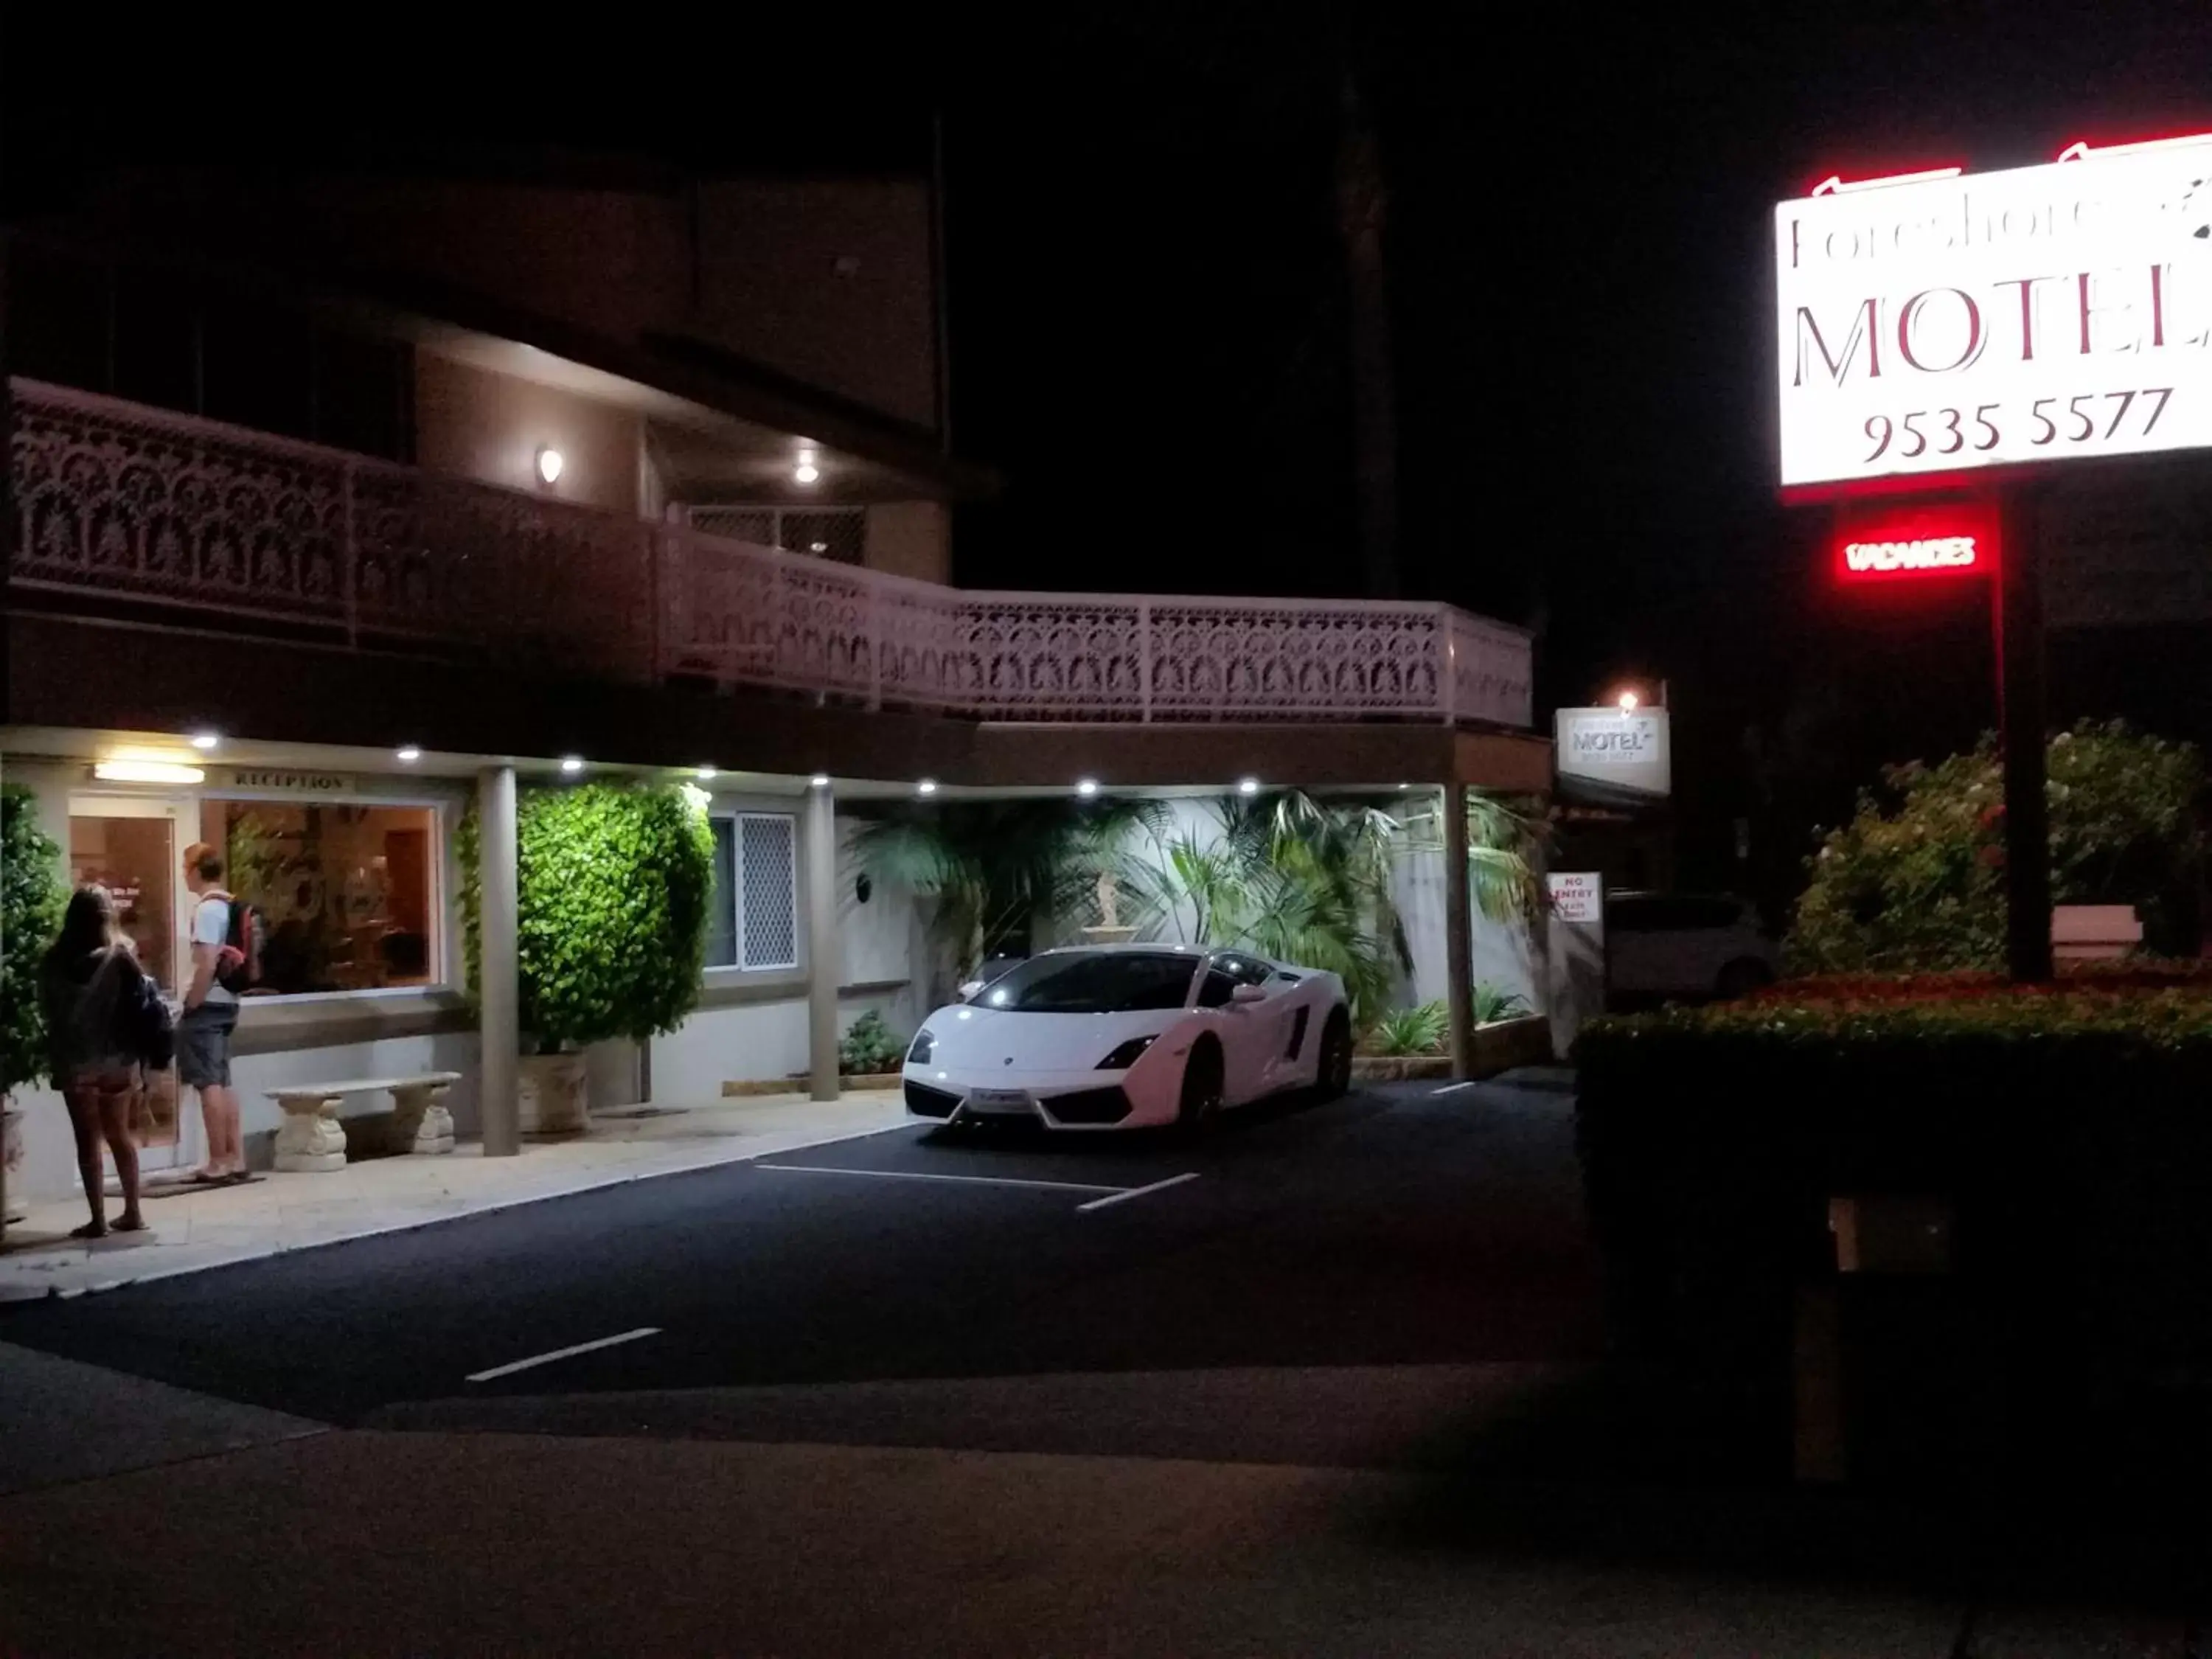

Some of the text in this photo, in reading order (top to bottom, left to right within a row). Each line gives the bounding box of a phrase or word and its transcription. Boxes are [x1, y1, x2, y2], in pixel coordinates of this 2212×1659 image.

[1793, 262, 2211, 389] MOTEL
[1863, 387, 2175, 464] 9535 5577
[1573, 731, 1644, 751] MOTEL
[235, 773, 344, 790] RECEPTION
[1565, 877, 1584, 886] NO
[1554, 888, 1593, 900] ENTRY
